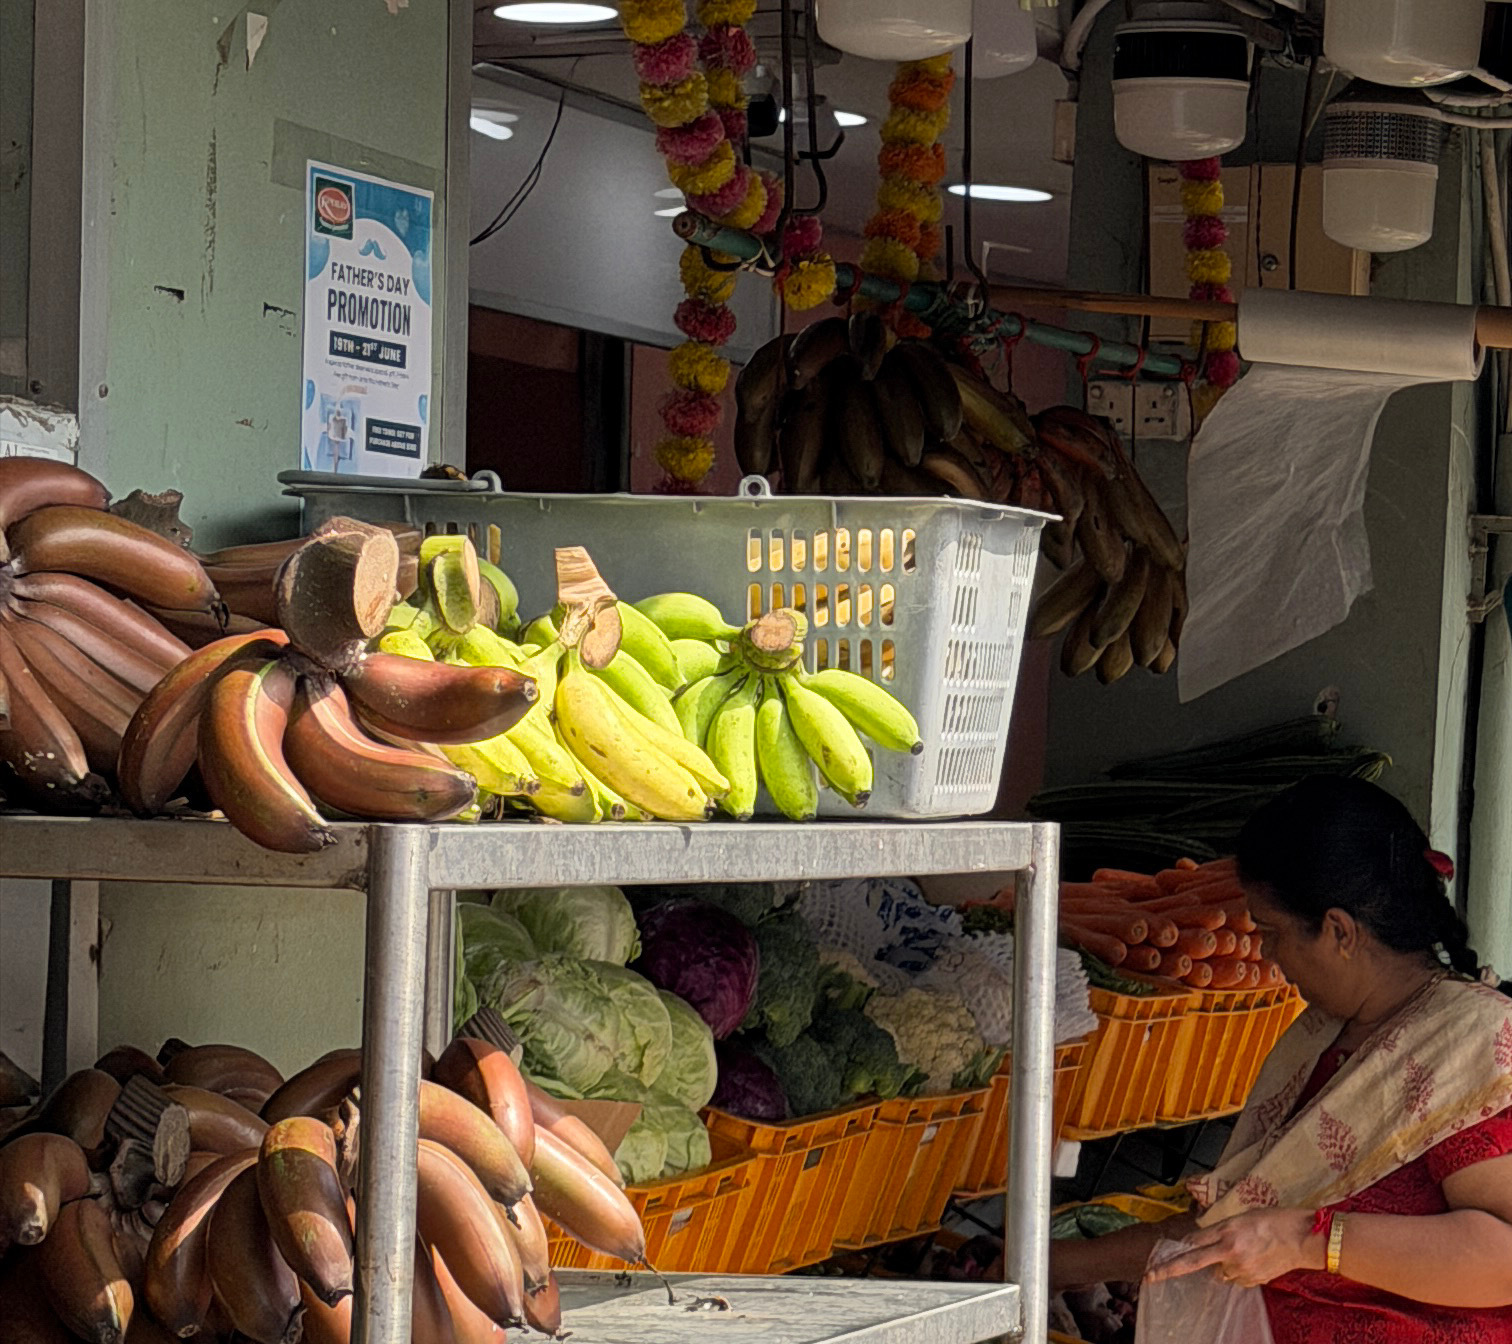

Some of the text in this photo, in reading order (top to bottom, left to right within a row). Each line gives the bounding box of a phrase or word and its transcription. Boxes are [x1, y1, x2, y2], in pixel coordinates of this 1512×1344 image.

[331, 261, 411, 296] FATHER'S DAY
[327, 288, 412, 337] PROMOTION
[333, 336, 355, 354] 19TH
[378, 345, 402, 363] JUNE
